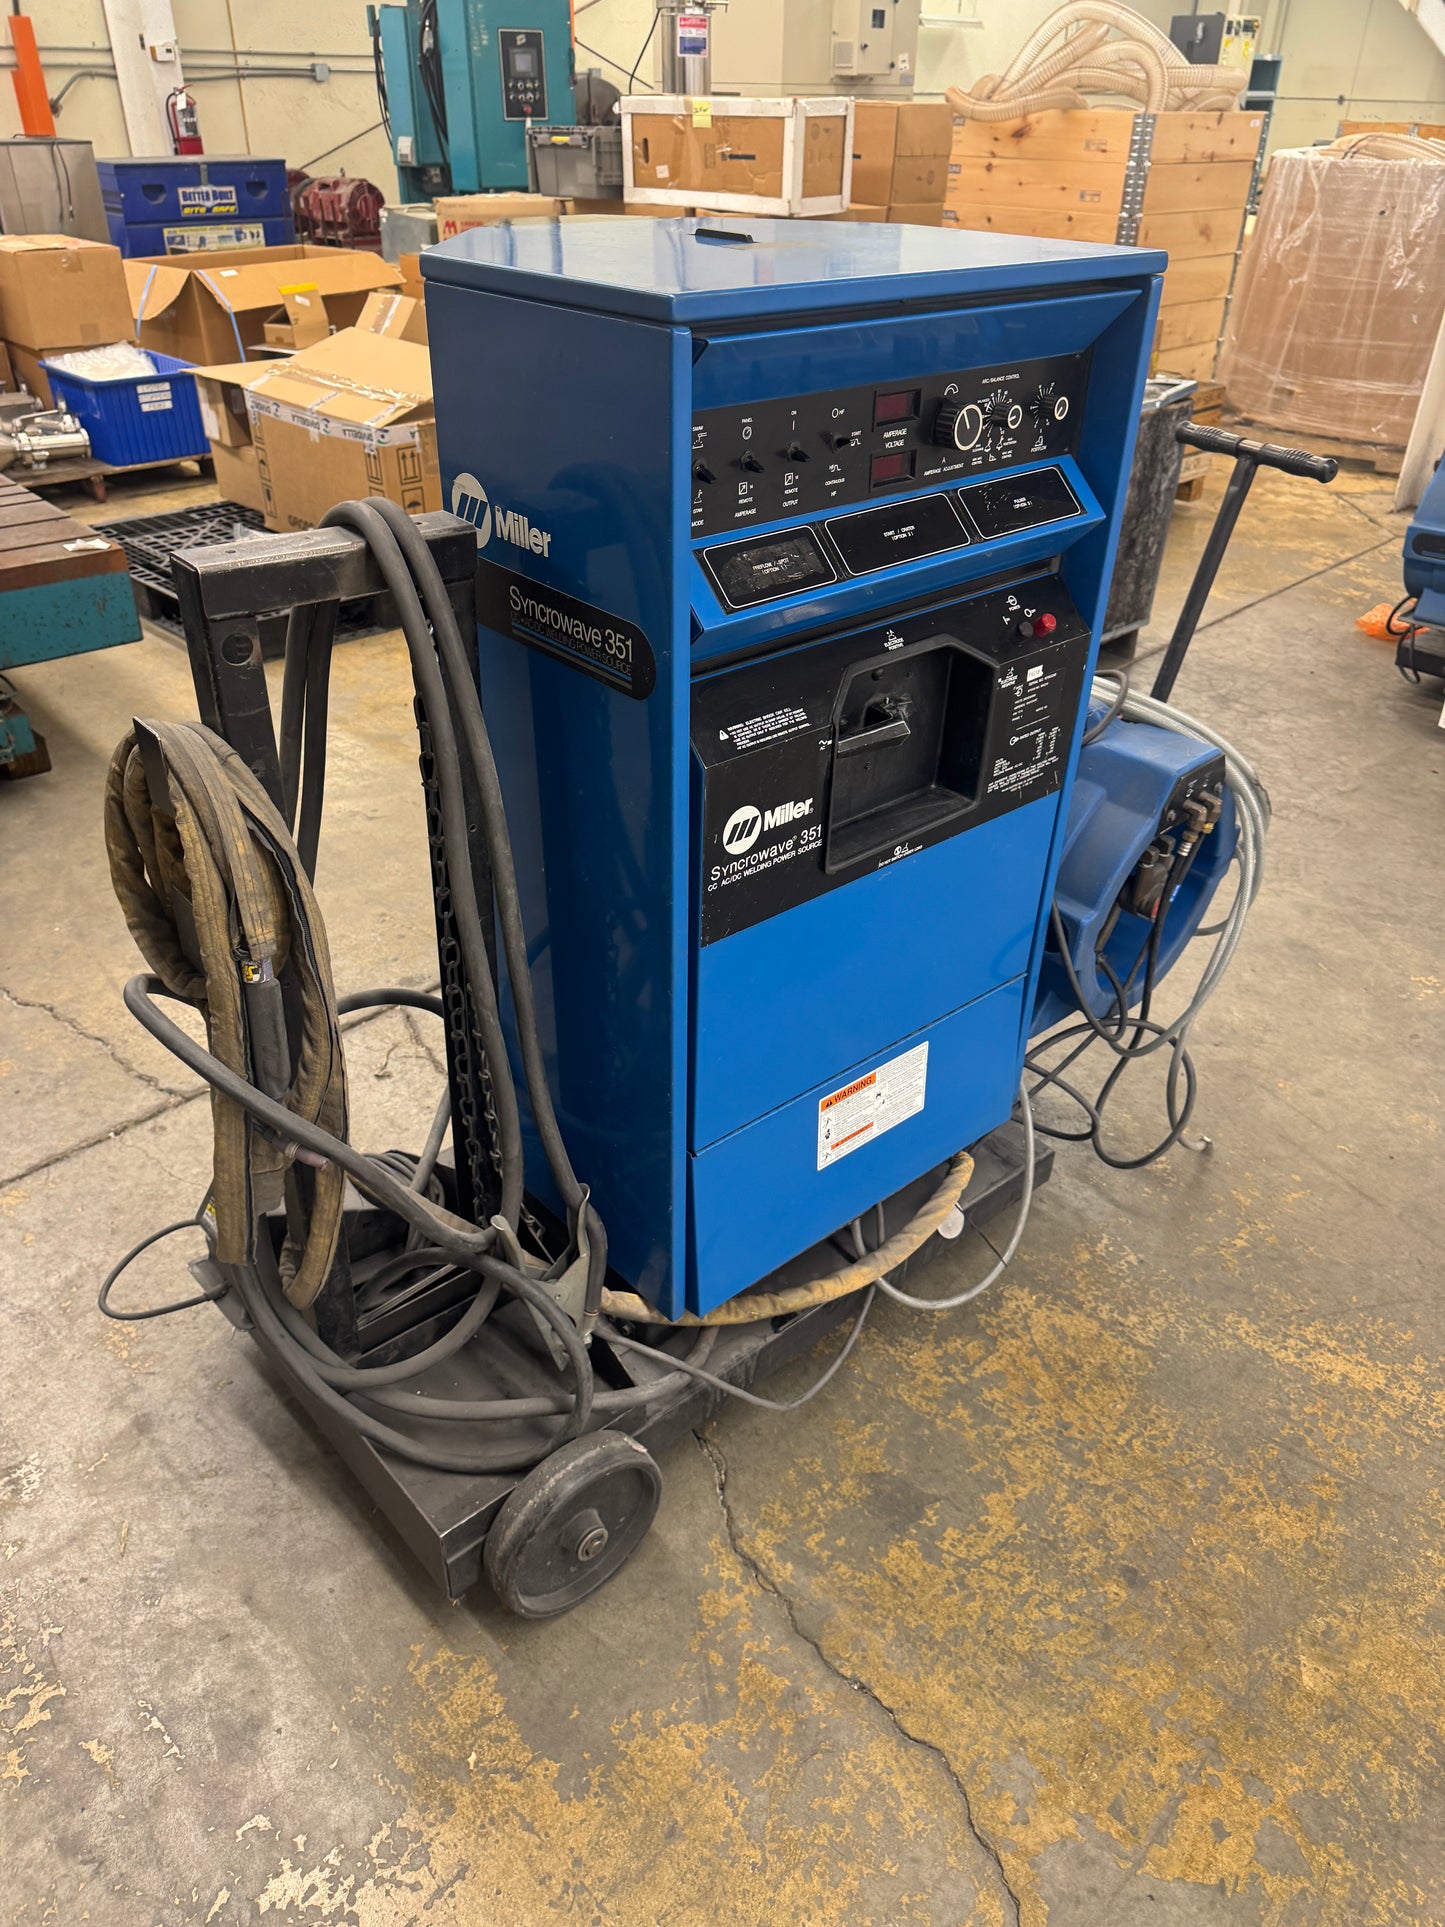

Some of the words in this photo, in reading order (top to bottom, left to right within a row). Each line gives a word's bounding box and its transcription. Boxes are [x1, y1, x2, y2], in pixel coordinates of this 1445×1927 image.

[181, 190, 210, 202] BETTER
[212, 189, 233, 201] BUILT
[882, 427, 908, 439] AMPERAGE
[884, 438, 905, 449] VOLTAGE
[923, 467, 942, 477] AMPERAGE
[942, 462, 964, 472] ADJUSTMENT
[824, 477, 846, 486] CONTINUOUS
[784, 487, 799, 495] REMOTE
[738, 496, 754, 504] REMOTE
[782, 498, 799, 508] OUTPUT
[733, 507, 757, 518] AMPERAGE
[495, 505, 552, 558] Miller
[883, 529, 896, 538] START
[752, 560, 773, 571] PREFLOW
[544, 627, 576, 650] WELDING
[576, 641, 602, 660] POWER
[602, 652, 632, 676] SOURCE
[604, 628, 633, 663] 351
[799, 823, 822, 845] 351
[707, 883, 718, 892] CC
[720, 872, 742, 888] AC/DC
[743, 860, 772, 878] WELDING
[772, 849, 796, 866] POWER
[797, 838, 823, 855] SOURCE
[833, 1074, 873, 1103] WARNING
